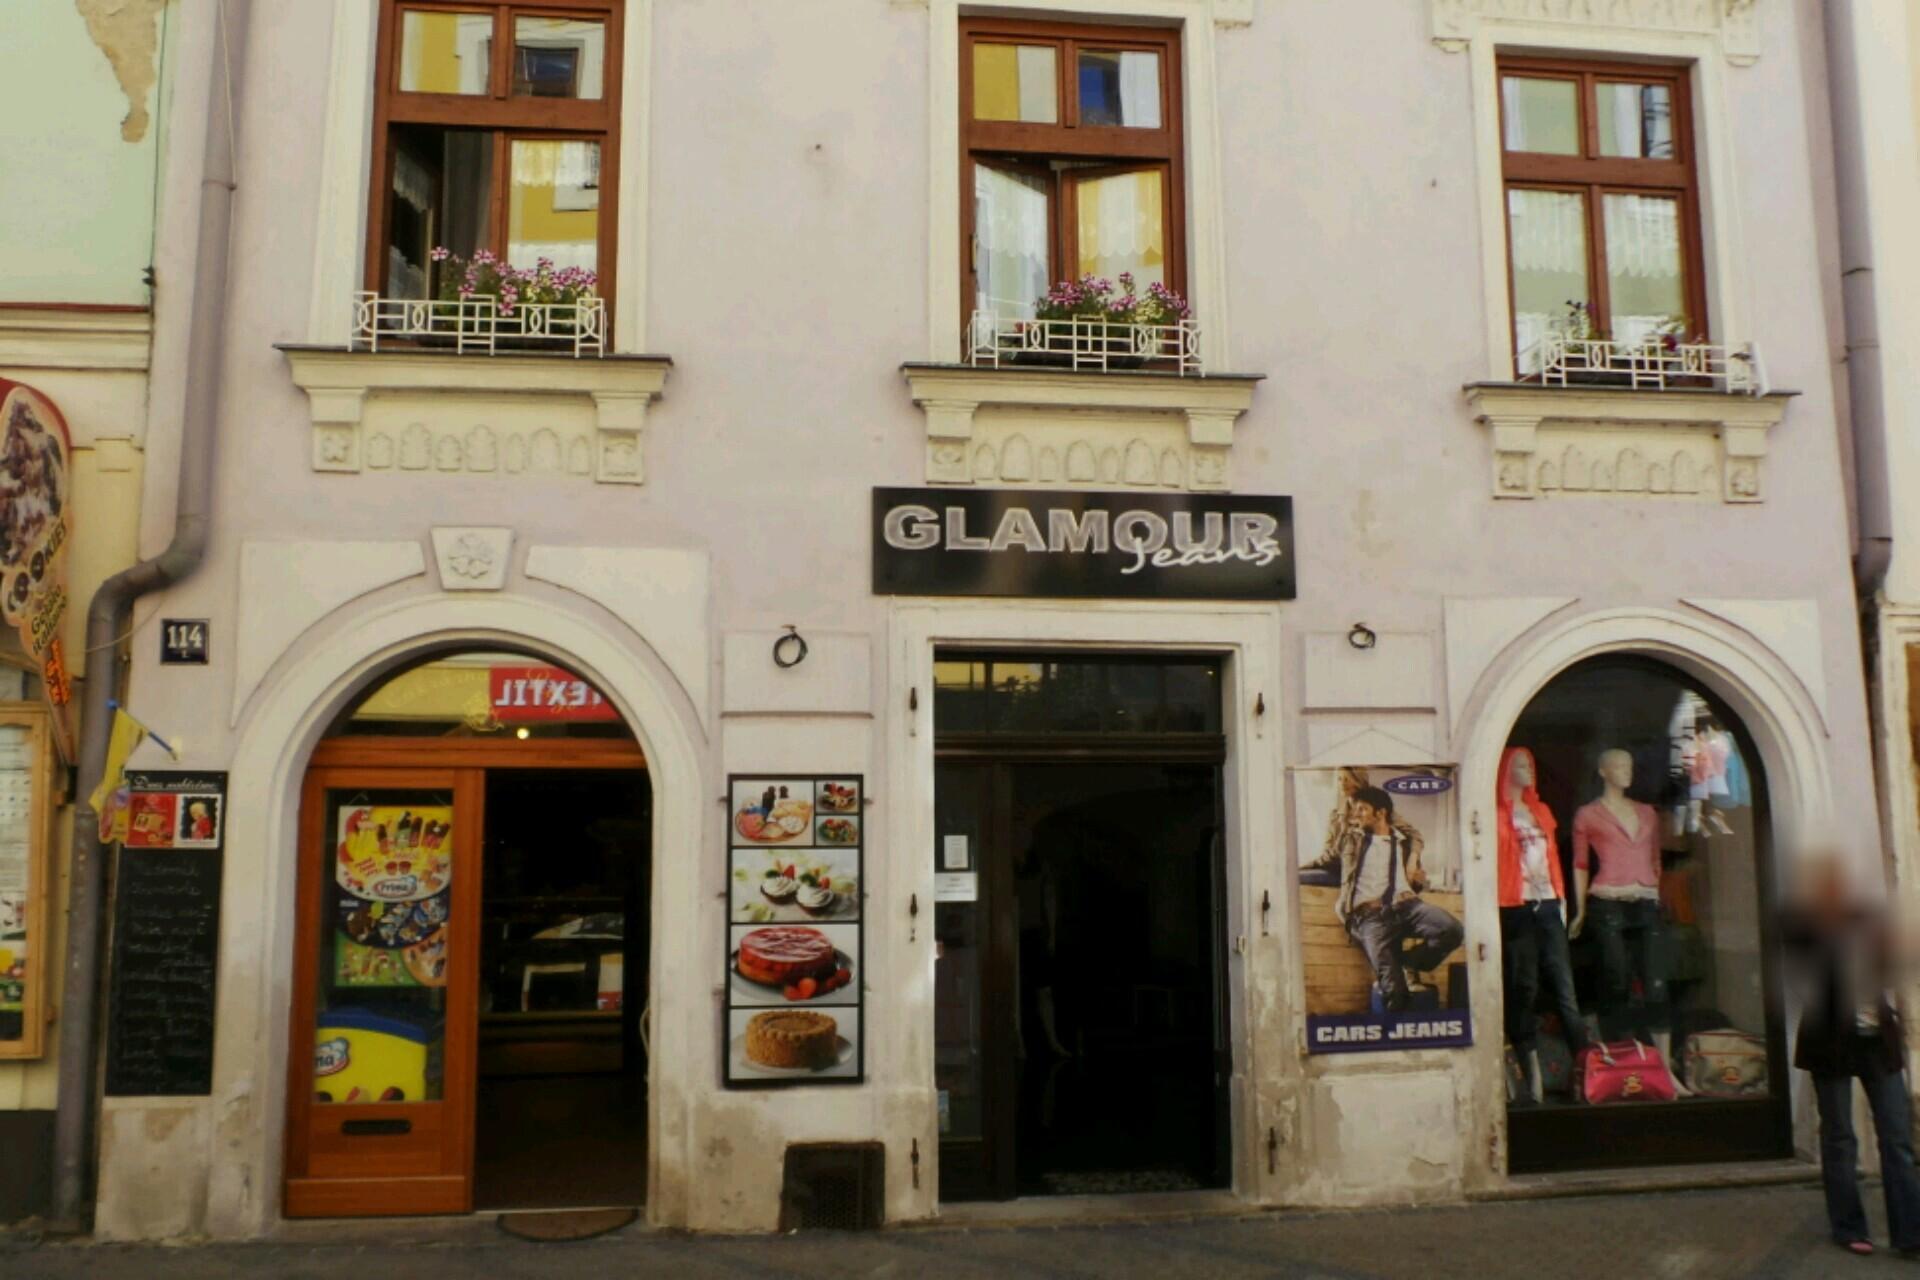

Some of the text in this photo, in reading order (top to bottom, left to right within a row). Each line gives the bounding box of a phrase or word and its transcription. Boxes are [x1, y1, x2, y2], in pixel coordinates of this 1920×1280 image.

[884, 504, 1280, 554] GLAMOUR
[1120, 536, 1281, 574] Jeans
[168, 625, 202, 648] 114
[1398, 781, 1439, 789] CARS
[1316, 1020, 1464, 1042] CARS JEANS
